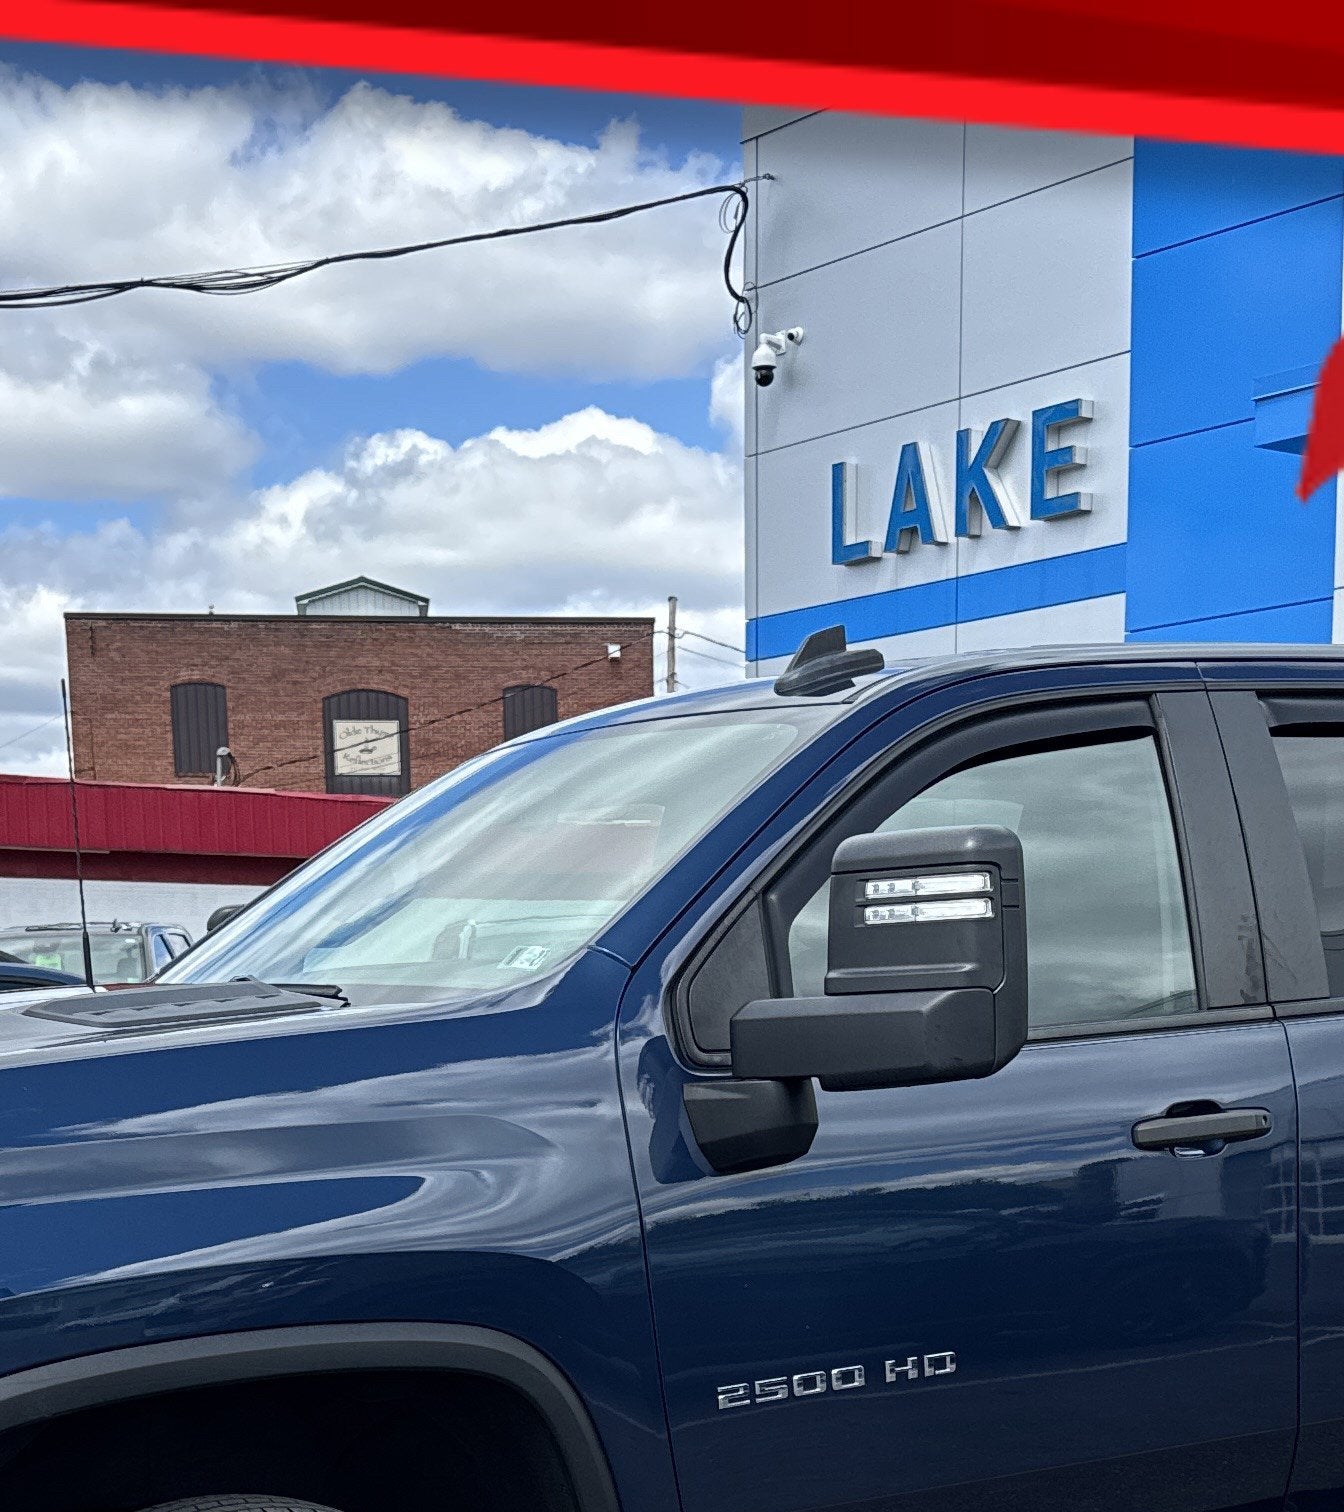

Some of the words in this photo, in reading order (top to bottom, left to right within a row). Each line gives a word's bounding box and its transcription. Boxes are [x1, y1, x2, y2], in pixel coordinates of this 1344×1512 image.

[832, 398, 1094, 566] LAKE
[717, 1365, 866, 1410] 2500
[884, 1351, 956, 1383] HD
